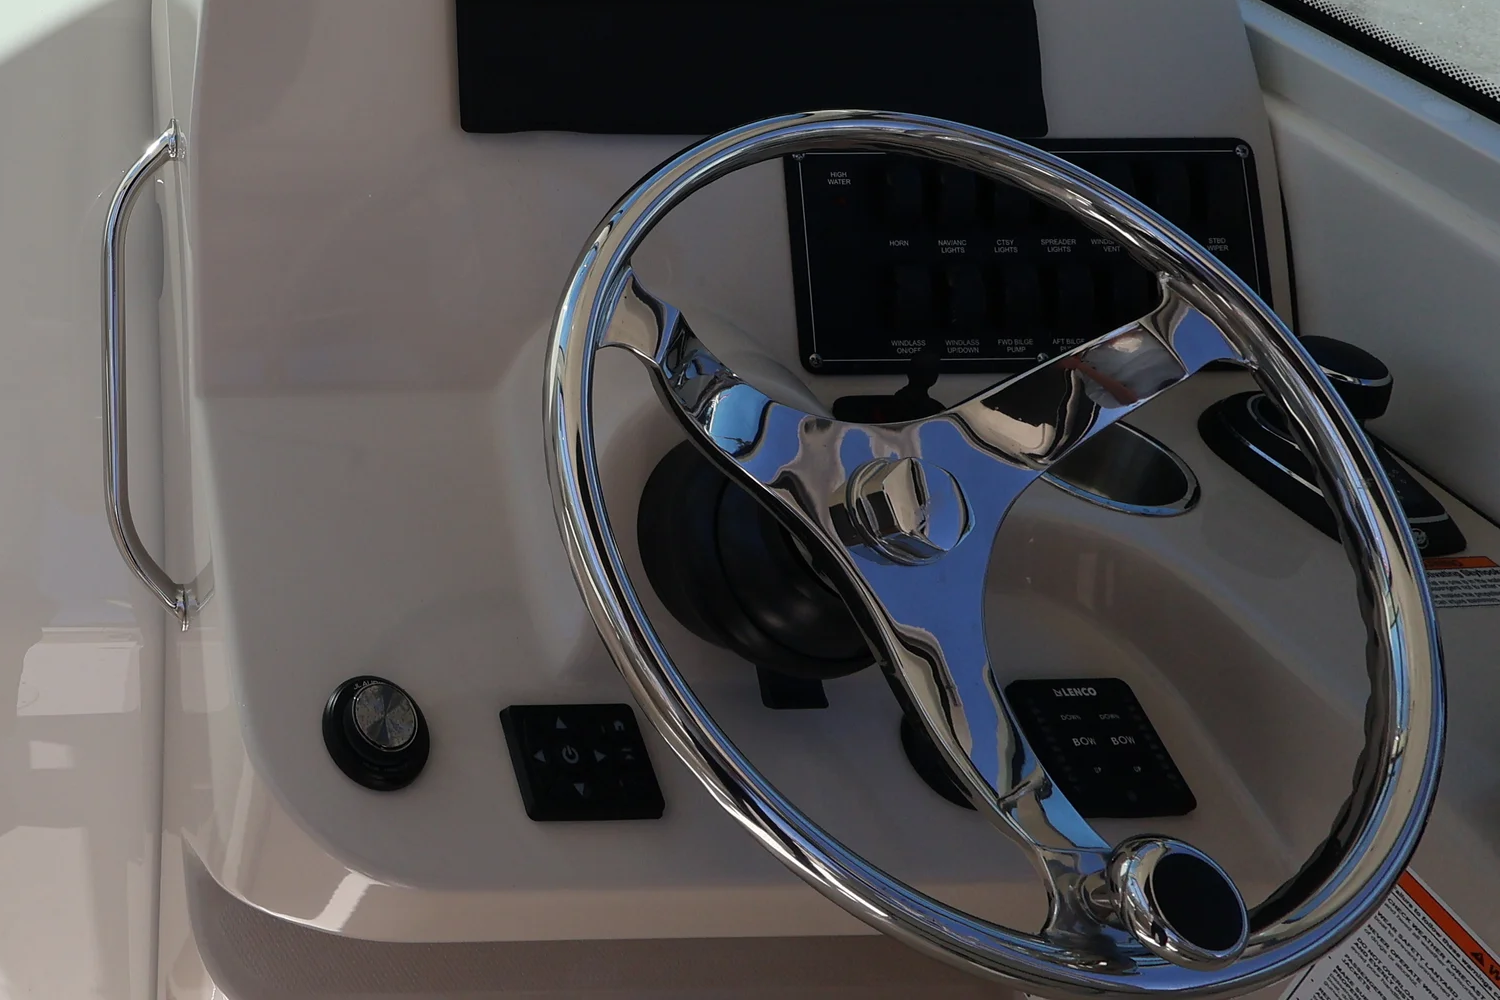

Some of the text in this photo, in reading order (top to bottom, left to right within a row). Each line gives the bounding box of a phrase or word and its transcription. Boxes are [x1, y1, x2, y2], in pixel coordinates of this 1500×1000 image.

[1103, 245, 1120, 253] VENT
[890, 339, 926, 347] WINDLASS
[947, 346, 980, 354] UP/DOWN
[1062, 687, 1098, 697] LENCO
[1099, 713, 1121, 721] DOWN
[1072, 735, 1136, 747] BOW BOW
[1356, 937, 1367, 949] DO
[1367, 949, 1381, 964] NOT
[1366, 923, 1390, 948] NEVER
[1389, 948, 1422, 983] OPERATE
[1376, 911, 1458, 998] WEAR SAFETY LANYARD
[1387, 897, 1485, 1000] CHECK WEATHER FORECAST
[1413, 908, 1421, 916] to
[1421, 916, 1442, 938] follow
[1442, 937, 1461, 958] these
[1460, 957, 1493, 991] warnings
[1353, 941, 1368, 957] AND
[1367, 957, 1394, 985] EVENLY
[1335, 964, 1354, 985] MAKE
